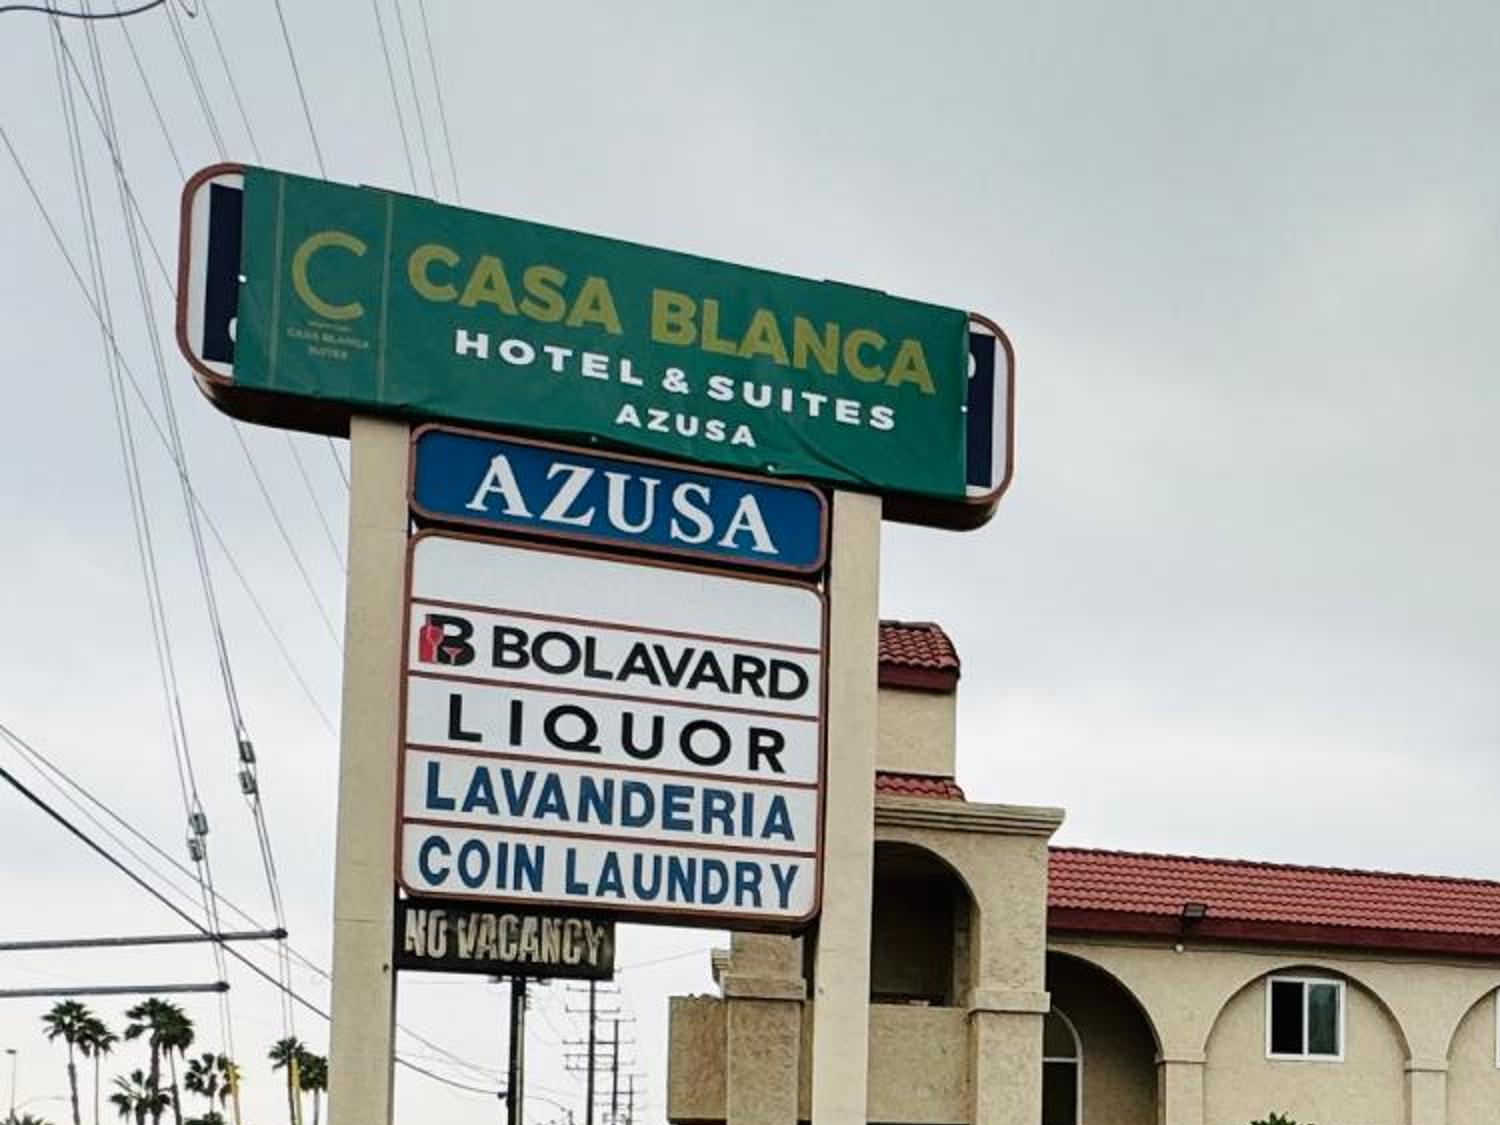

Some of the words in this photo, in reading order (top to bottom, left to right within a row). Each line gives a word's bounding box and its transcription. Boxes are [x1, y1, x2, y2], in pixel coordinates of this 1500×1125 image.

[407, 243, 623, 335] CASA
[652, 288, 936, 394] BLANCA
[455, 329, 643, 386] HOTEL
[661, 367, 689, 394] &
[707, 375, 895, 430] SUITES
[615, 403, 756, 448] AZUSA
[465, 453, 779, 554] AZUSA
[491, 625, 809, 701] BOLAVARD
[447, 693, 785, 774] LIQUOR
[425, 761, 795, 842] LAVANDERIA
[419, 835, 545, 893] COIN
[565, 848, 799, 909] LAUNDRY
[404, 909, 449, 959] NO
[456, 912, 605, 966] VACANCY
